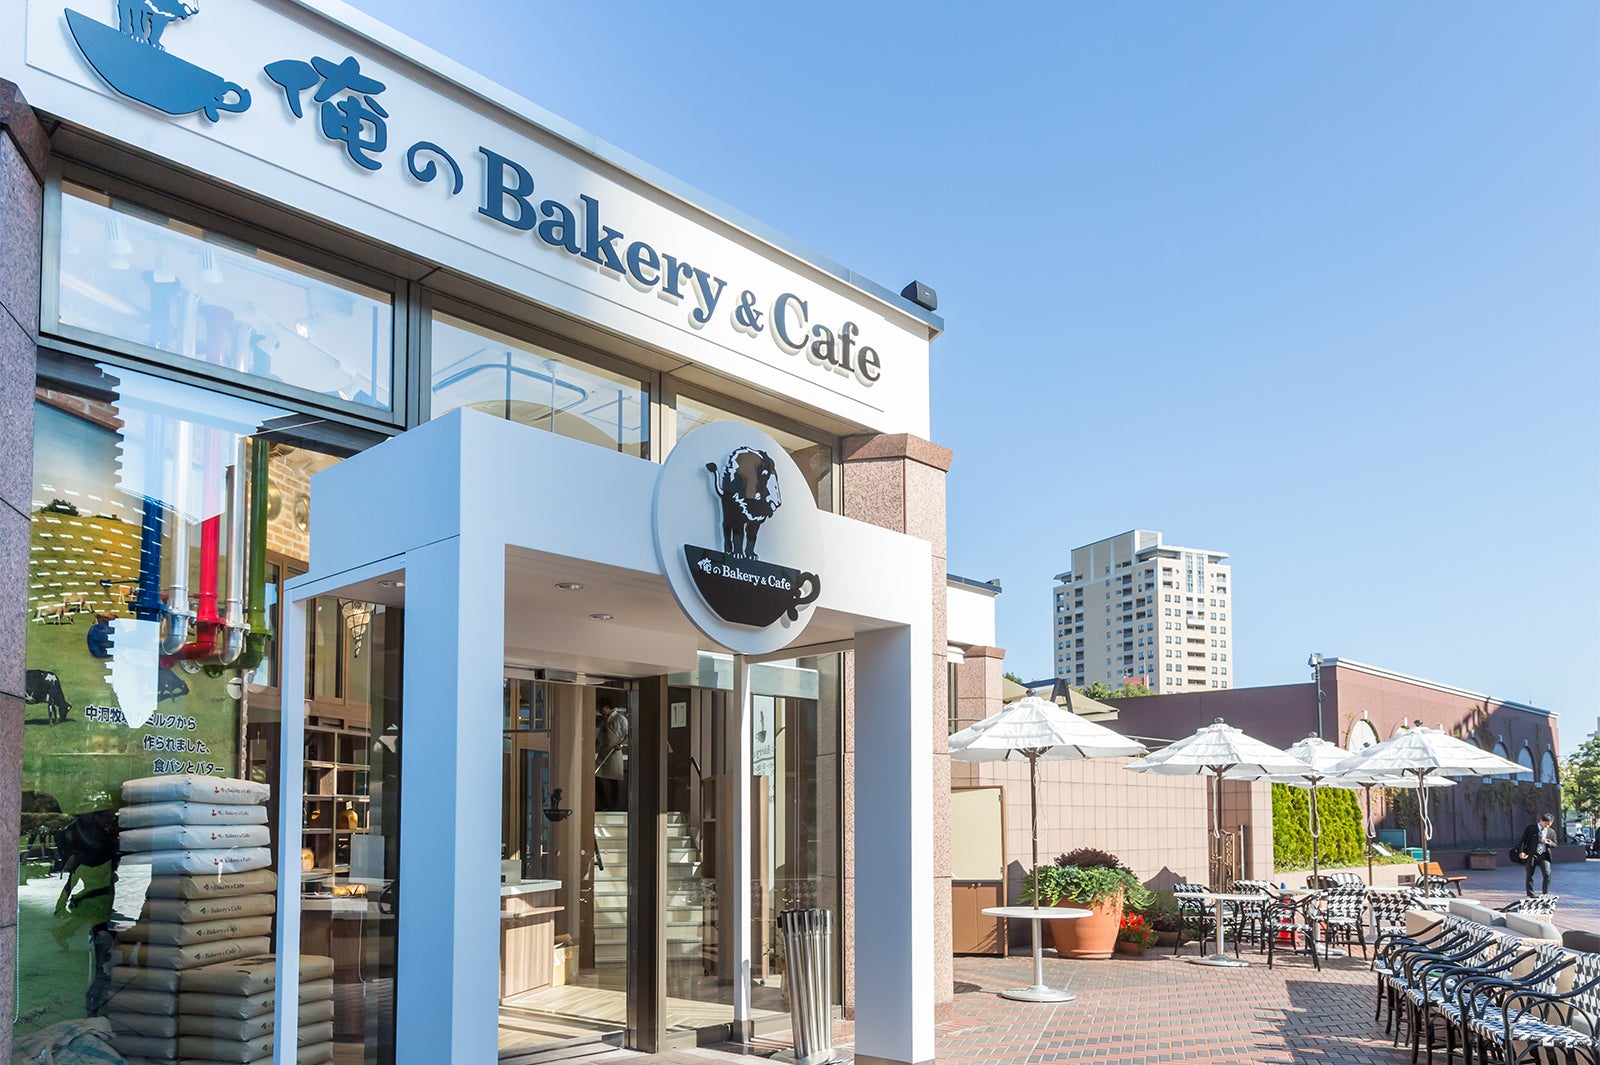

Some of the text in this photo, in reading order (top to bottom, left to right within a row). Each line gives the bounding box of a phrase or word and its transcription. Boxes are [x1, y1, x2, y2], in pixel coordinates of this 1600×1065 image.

[263, 56, 882, 384] 俺の Bakery & Cafe
[722, 564, 761, 586] Bakery
[761, 576, 767, 586] &
[768, 575, 791, 590] Cafe
[143, 735, 210, 753] 作られました、
[154, 758, 224, 775] 食パンとバター
